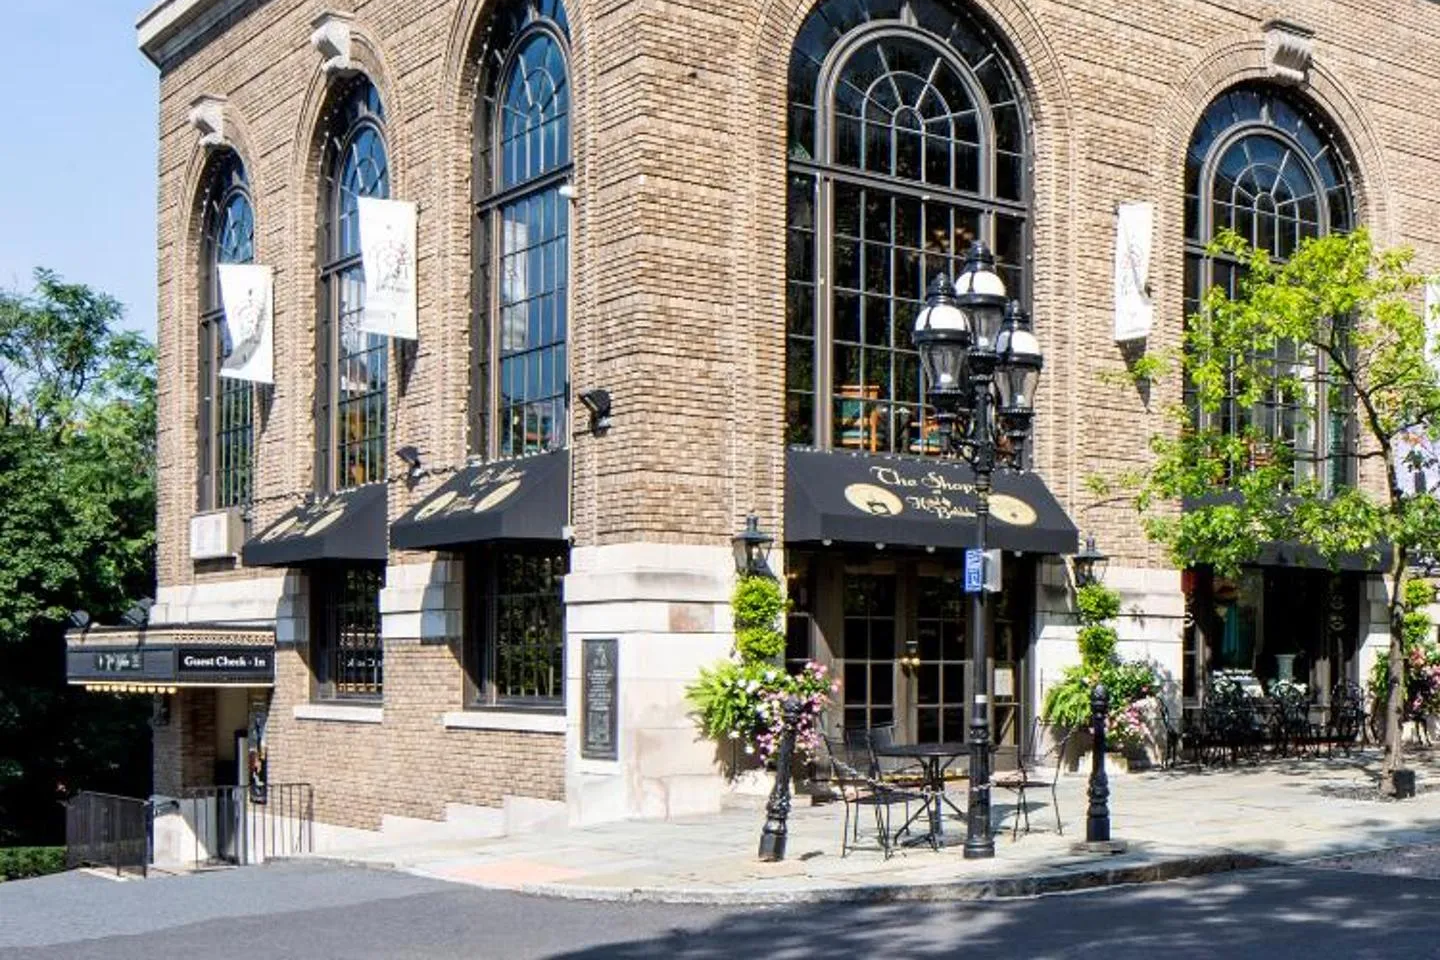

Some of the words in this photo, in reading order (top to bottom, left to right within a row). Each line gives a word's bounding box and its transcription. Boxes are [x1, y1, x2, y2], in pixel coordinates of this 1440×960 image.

[869, 465, 918, 486] The
[921, 472, 978, 495] Shop
[183, 656, 214, 668] Guest
[216, 656, 246, 668] Check
[253, 657, 266, 668] In
